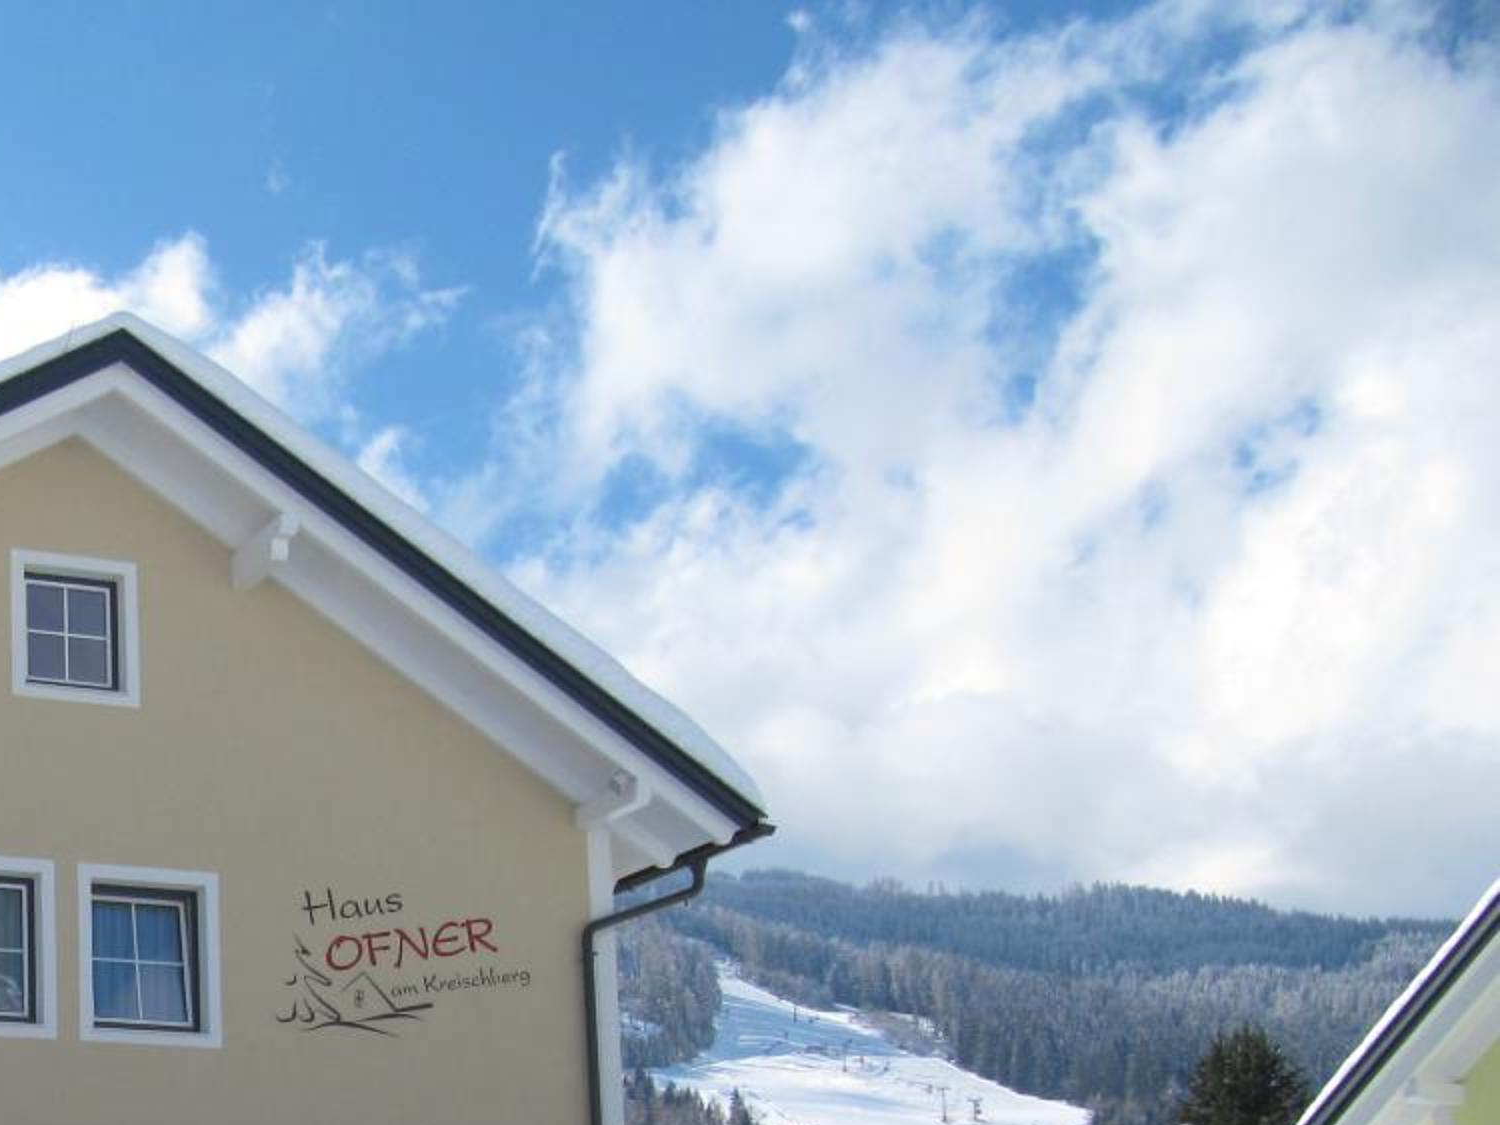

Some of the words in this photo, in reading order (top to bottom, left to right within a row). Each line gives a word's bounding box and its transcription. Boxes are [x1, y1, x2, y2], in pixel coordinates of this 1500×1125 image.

[302, 887, 403, 925] Haus
[325, 917, 499, 971] OFNER
[390, 983, 419, 998] am
[422, 967, 532, 993] Kreischberg
